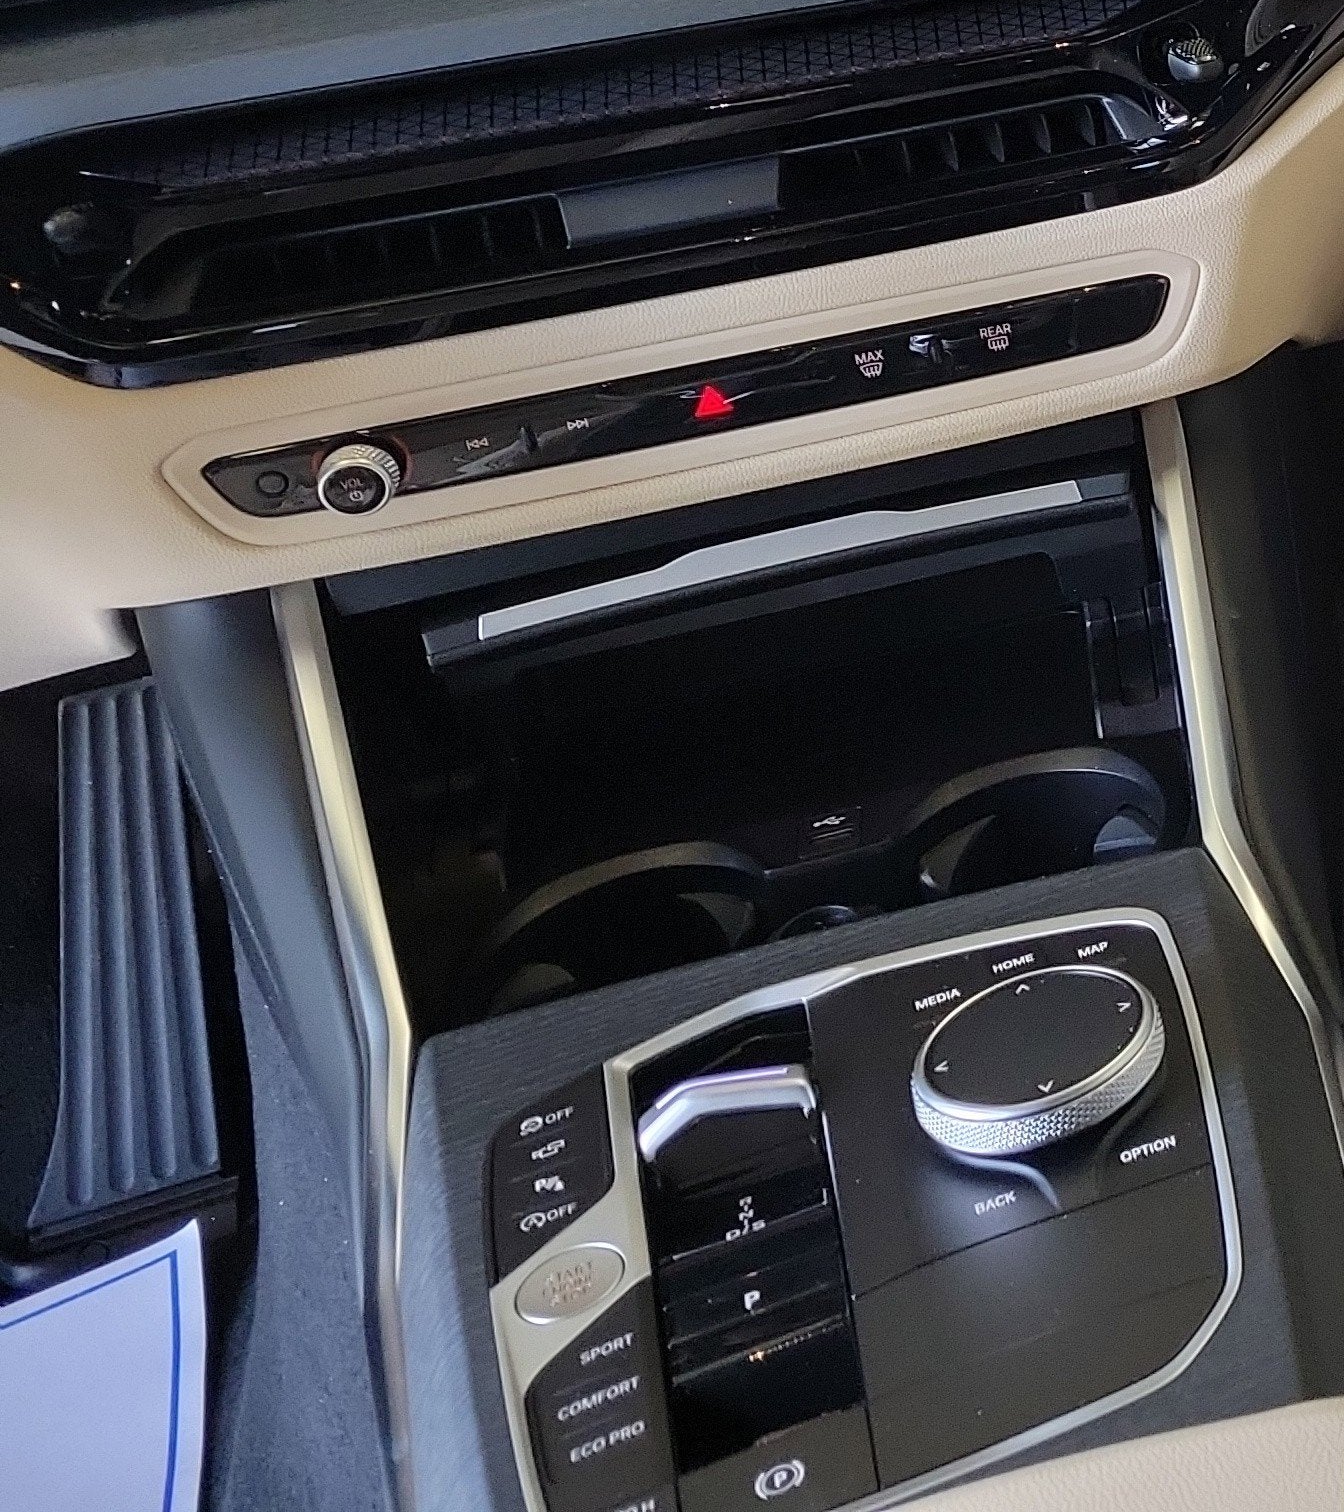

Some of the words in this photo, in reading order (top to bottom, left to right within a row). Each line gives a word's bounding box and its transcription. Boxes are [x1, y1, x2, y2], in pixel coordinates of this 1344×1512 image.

[978, 322, 1013, 339] REAR
[854, 349, 885, 366] MAX
[1077, 940, 1109, 959] MAP
[992, 953, 1036, 975] HOME
[914, 987, 963, 1012] MEDIA
[545, 1105, 574, 1125] OFF
[1119, 1134, 1177, 1164] OPTION
[546, 1201, 578, 1221] OFF
[973, 1190, 1017, 1216] BACK
[743, 1289, 761, 1311] P
[580, 1331, 634, 1366] SPORT
[556, 1374, 641, 1422] COMFORT
[570, 1436, 607, 1464] ECO
[609, 1419, 646, 1446] PRO
